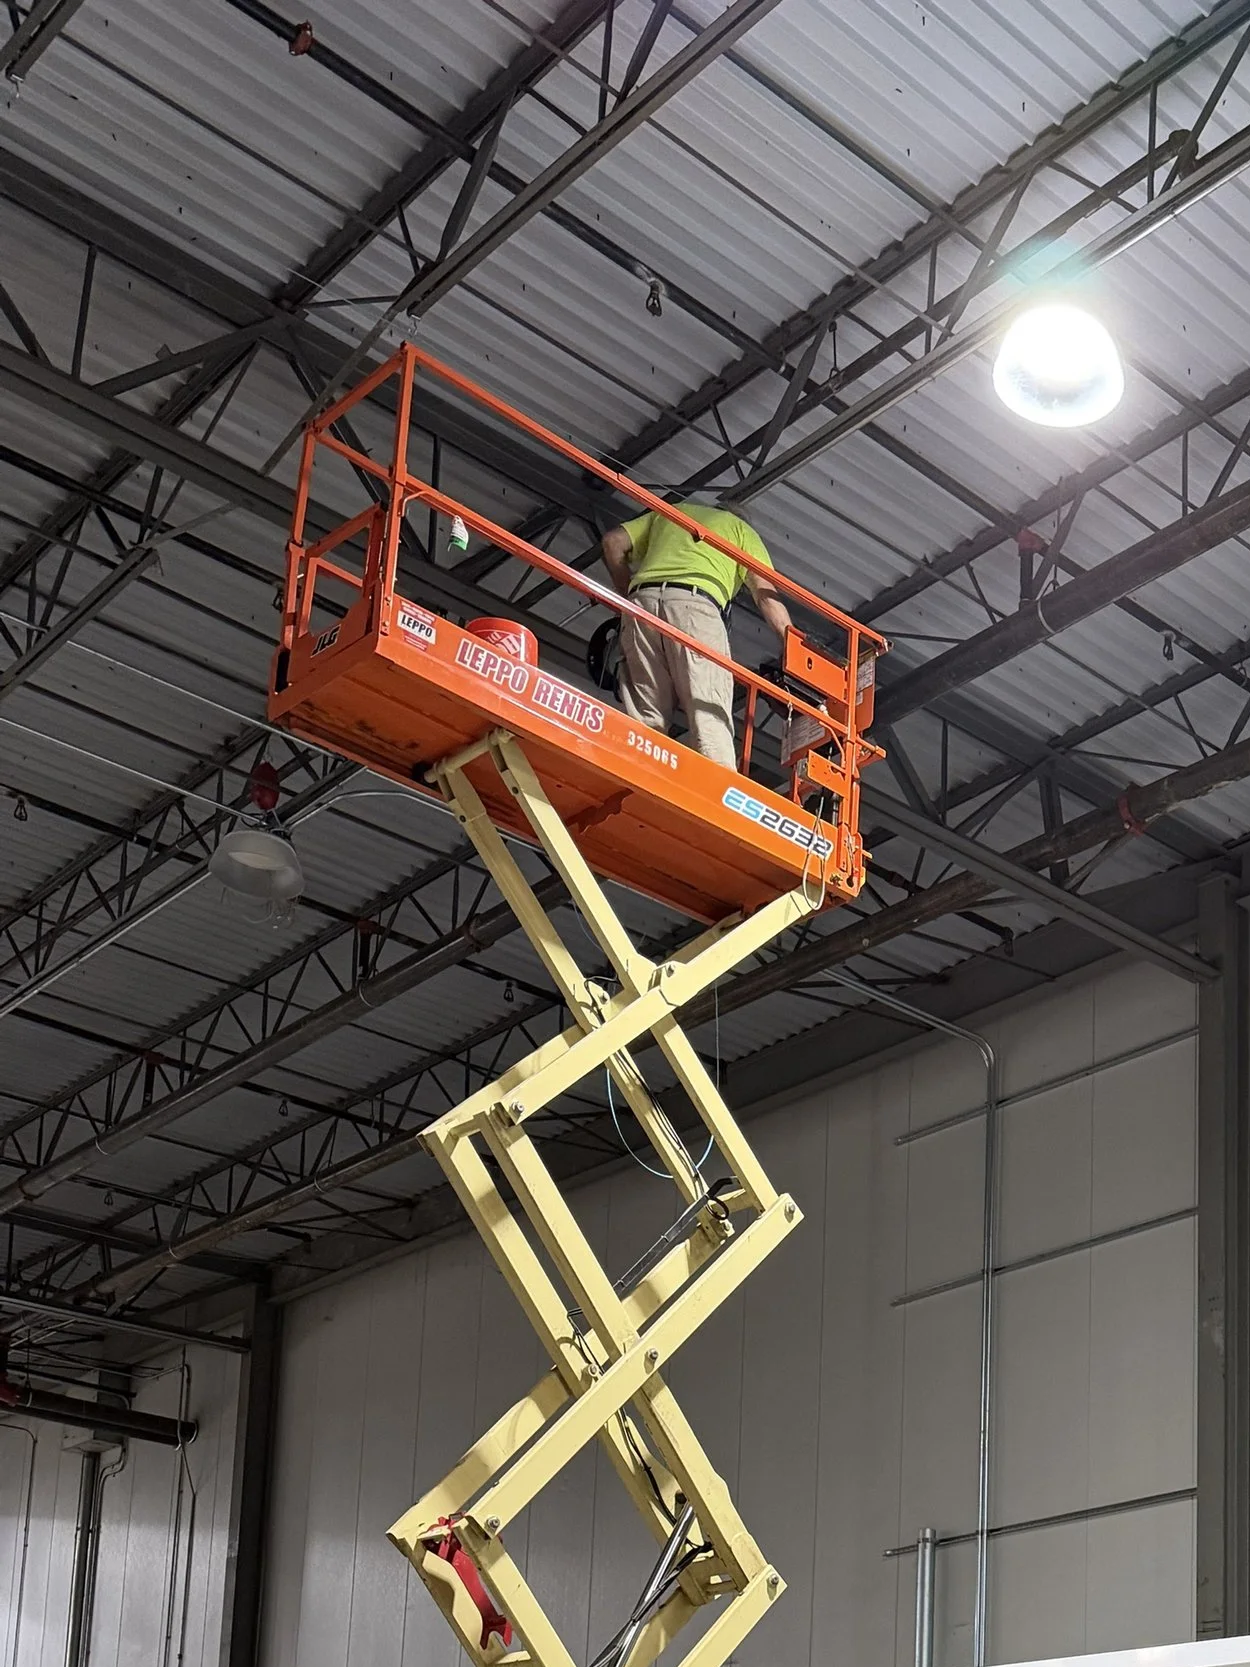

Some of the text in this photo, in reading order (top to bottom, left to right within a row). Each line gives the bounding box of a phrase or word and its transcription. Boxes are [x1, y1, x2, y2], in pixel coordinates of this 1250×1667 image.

[311, 624, 341, 658] JLG
[401, 614, 433, 638] LEPPO
[456, 638, 529, 694] LEPPO
[532, 677, 604, 733] RENTS
